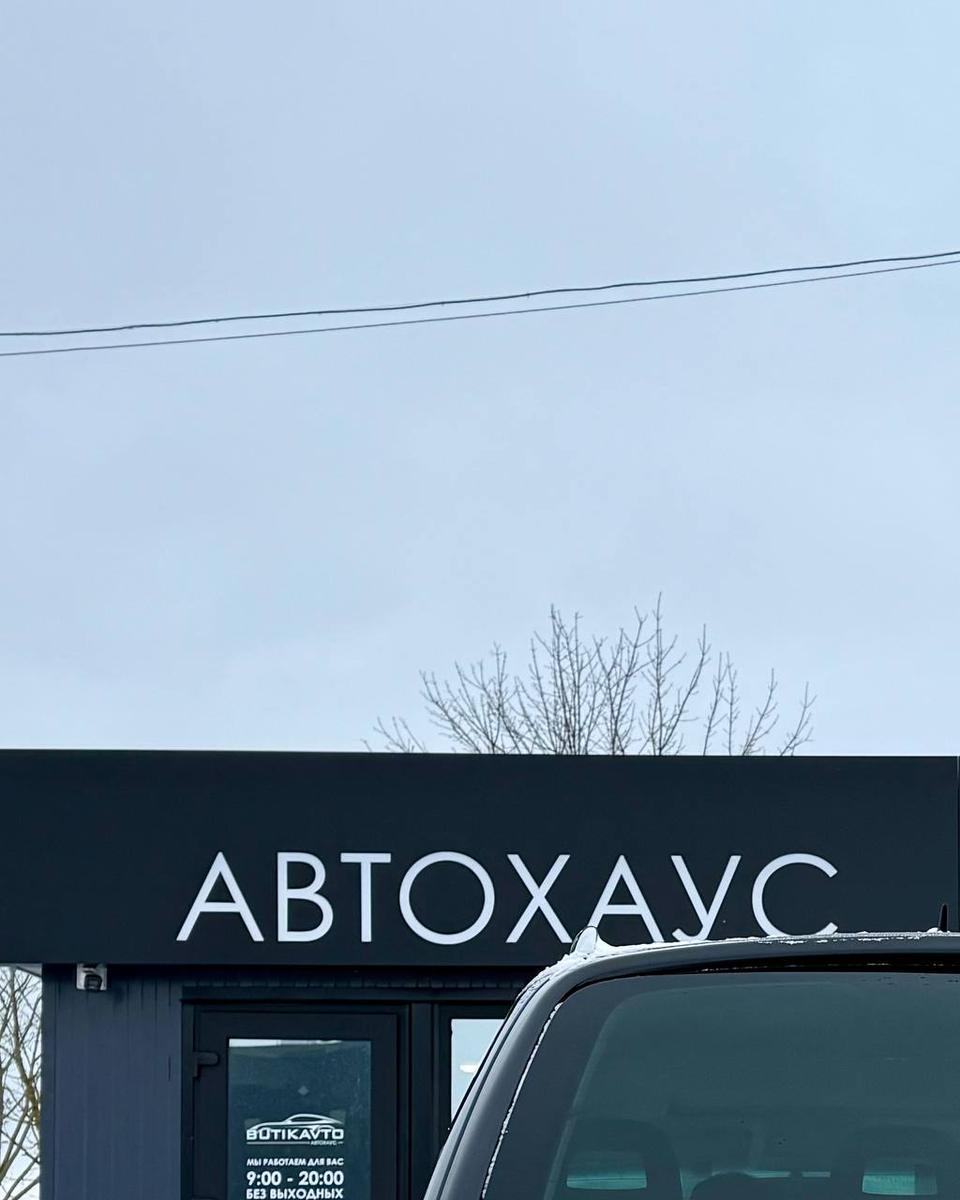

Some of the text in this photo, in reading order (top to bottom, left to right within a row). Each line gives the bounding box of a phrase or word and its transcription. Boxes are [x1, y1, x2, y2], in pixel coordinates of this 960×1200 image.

[176, 851, 838, 945] АВТОХАУС
[246, 1128, 344, 1140] BUTIKAVTO
[246, 1158, 344, 1167] МЫ РАБОТАЕМ ДЛЯ ВАС
[246, 1170, 282, 1186] 9:00
[298, 1170, 344, 1186] 20:00
[246, 1188, 344, 1200] БЕЗ ВЫХОДНЫХ
